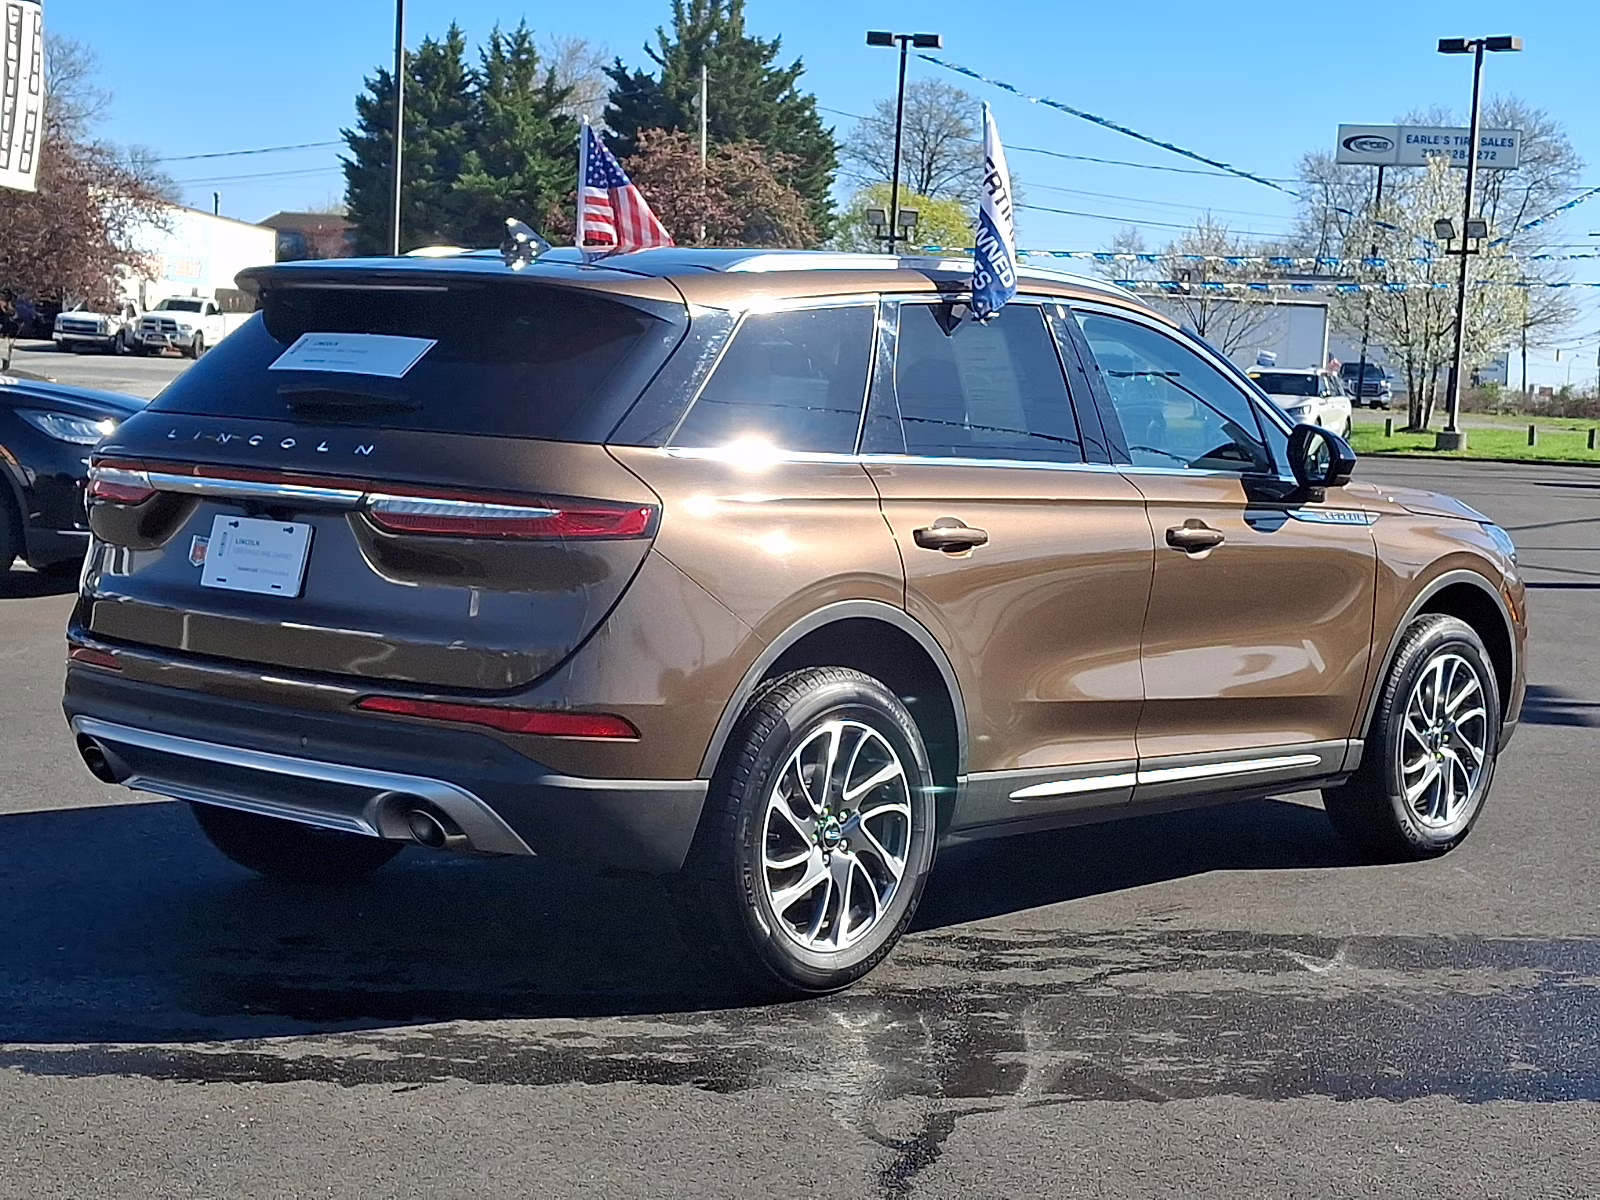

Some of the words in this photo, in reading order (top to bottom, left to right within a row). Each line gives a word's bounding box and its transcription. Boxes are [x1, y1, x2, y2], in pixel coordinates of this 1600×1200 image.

[1406, 134, 1450, 146] EARLE'S
[1454, 136, 1472, 146] TIR
[1480, 137, 1514, 148] SALES
[167, 429, 375, 456] LINCOLN
